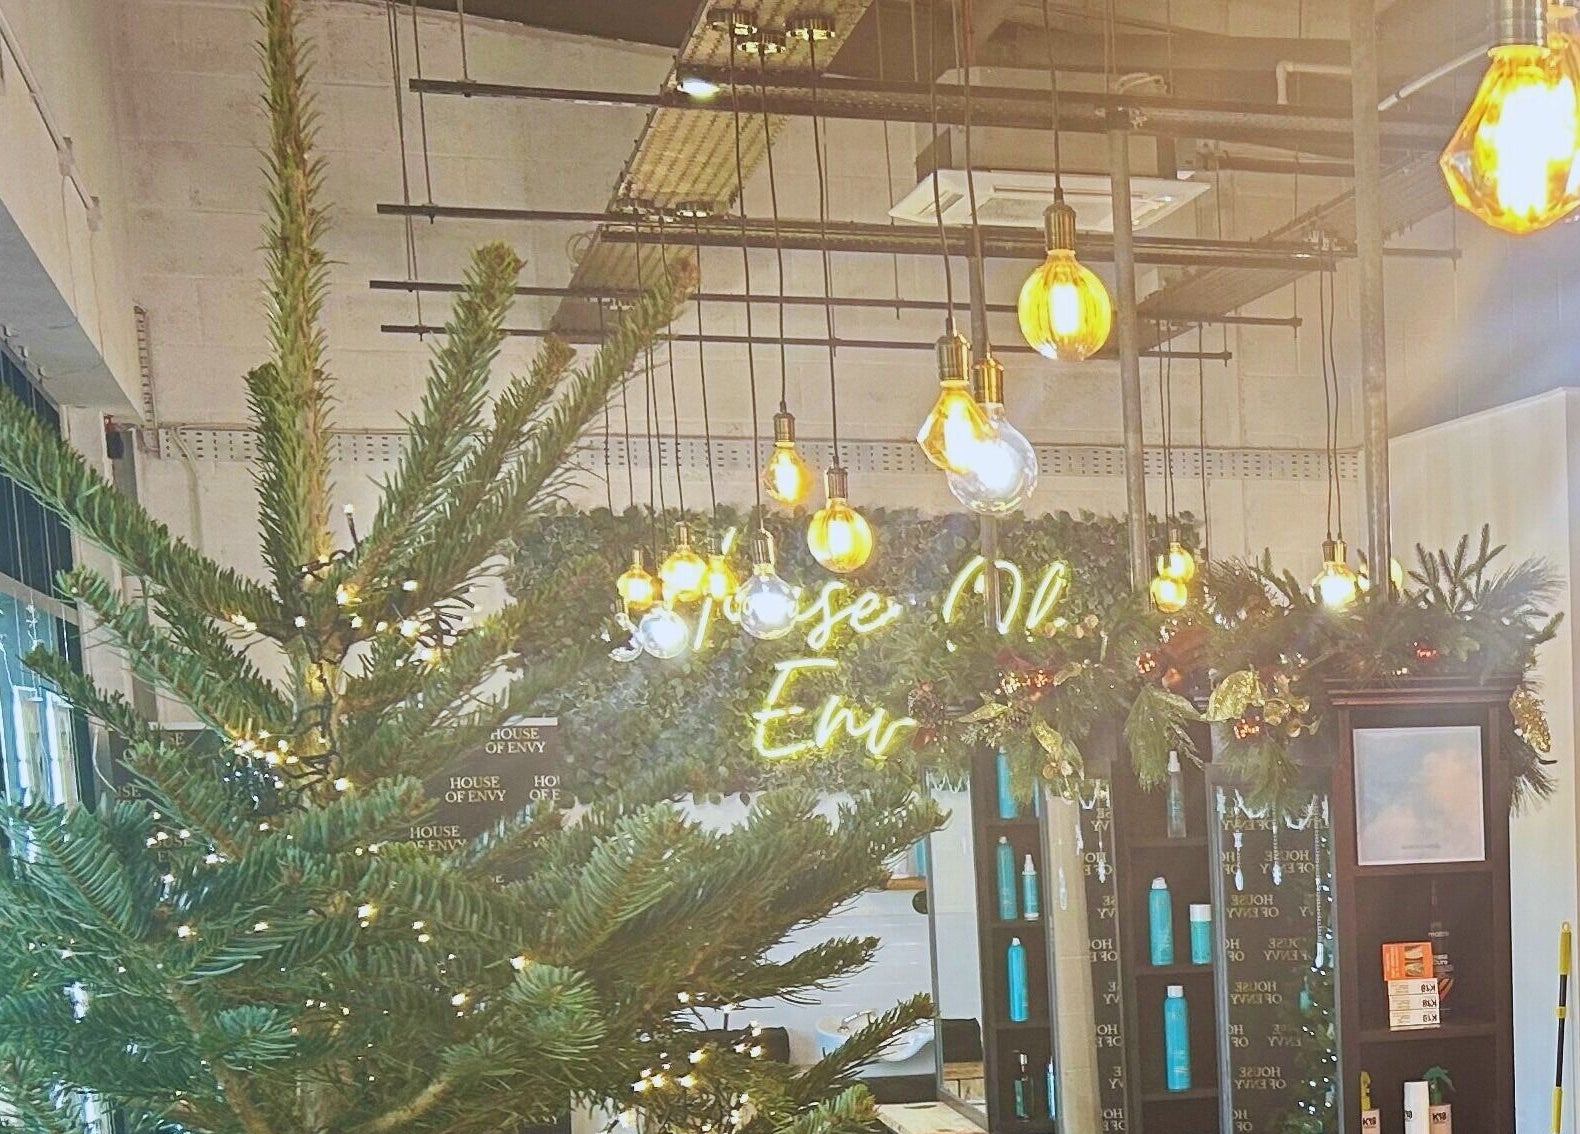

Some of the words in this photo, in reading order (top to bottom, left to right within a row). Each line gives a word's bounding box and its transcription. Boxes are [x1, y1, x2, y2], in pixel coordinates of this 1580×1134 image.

[490, 727, 540, 740] HOUSE
[485, 742, 506, 754] OF
[507, 740, 546, 753] ENVY
[449, 775, 501, 789] HOUSE
[445, 790, 465, 803] OF
[468, 789, 506, 802] ENVY
[529, 788, 548, 801] OF
[409, 825, 460, 839] HOUSE
[1362, 1116, 1377, 1126] K18
[1432, 1111, 1447, 1121] K18
